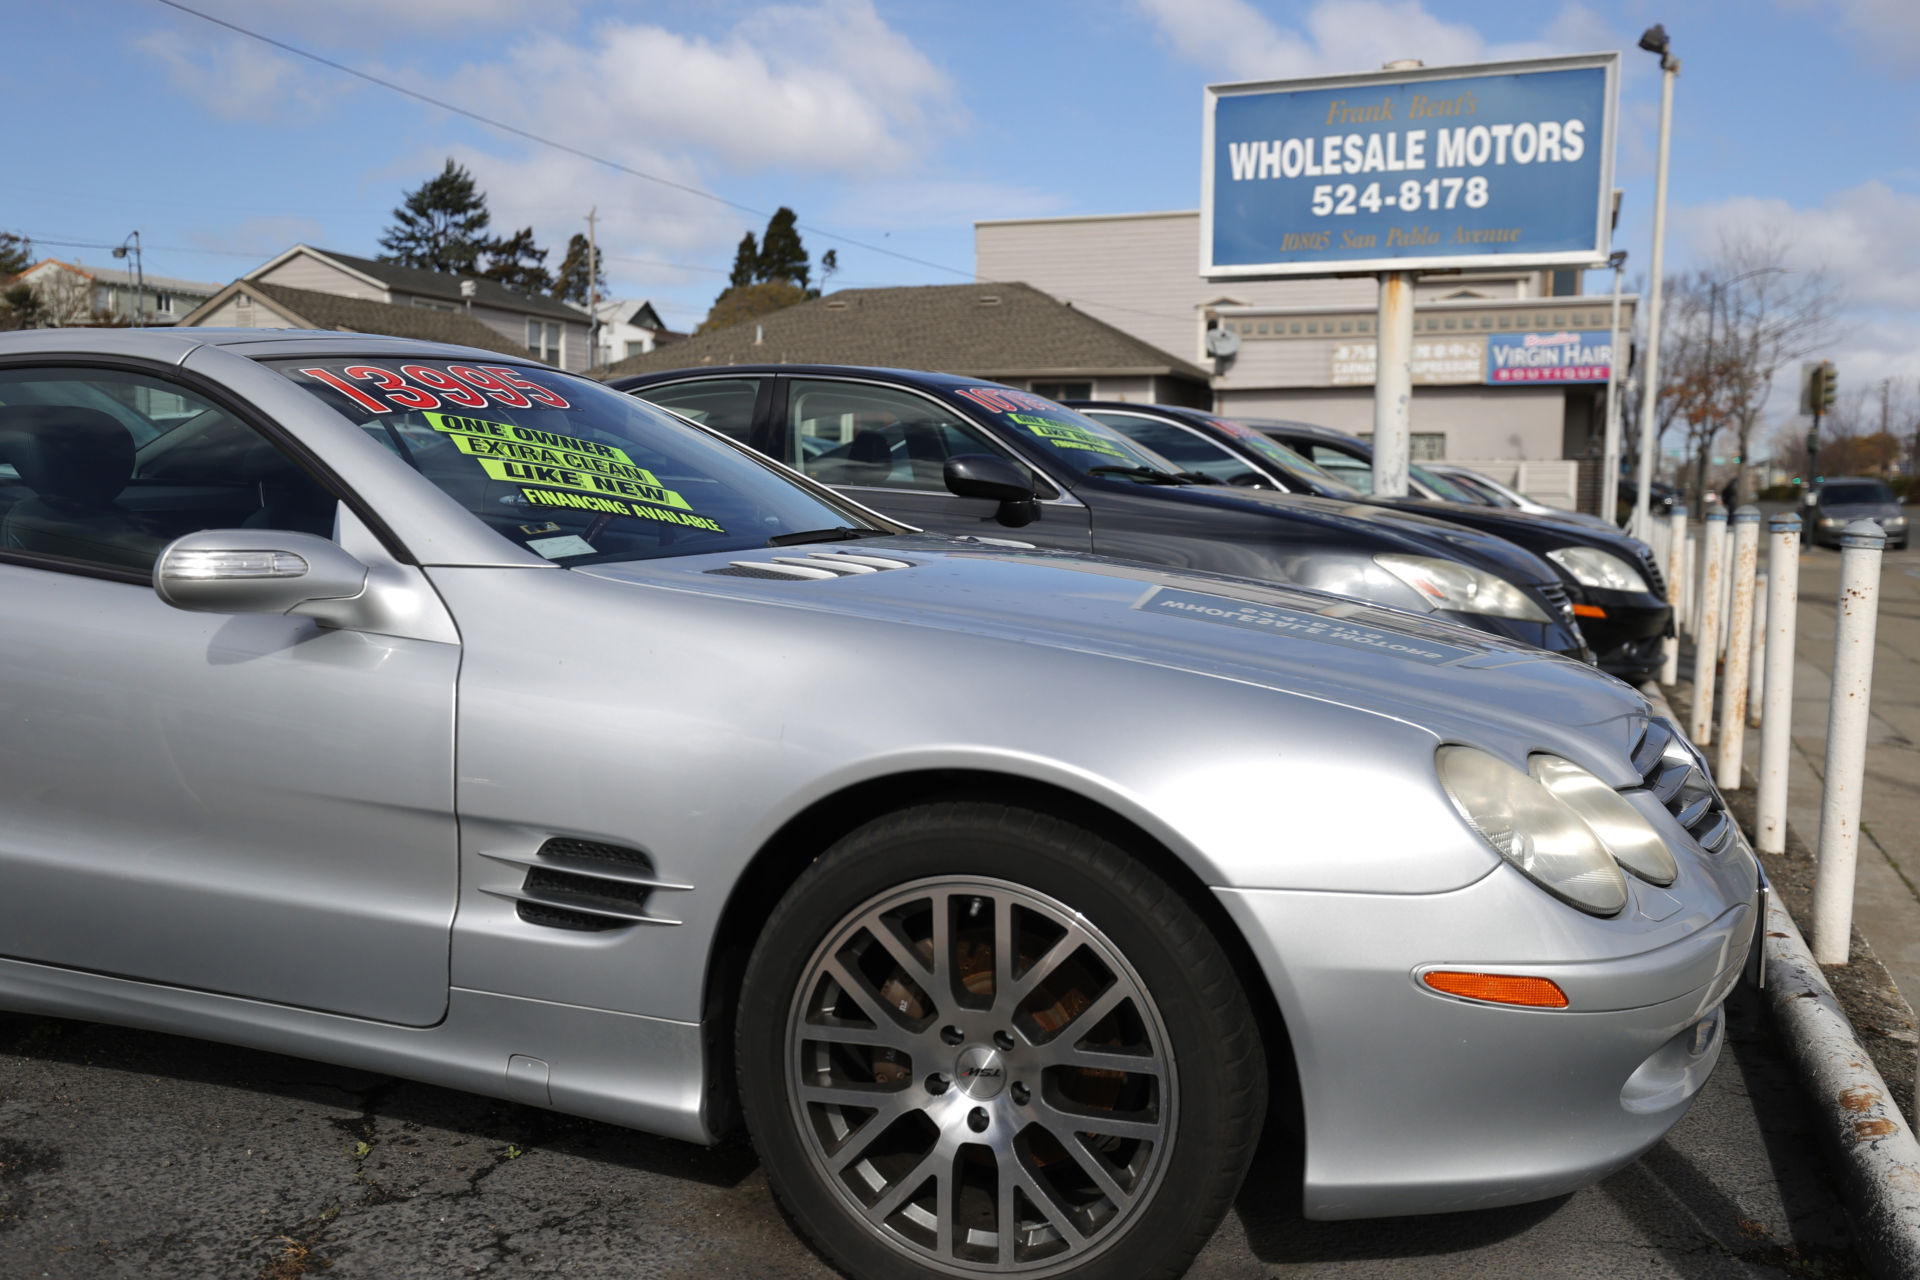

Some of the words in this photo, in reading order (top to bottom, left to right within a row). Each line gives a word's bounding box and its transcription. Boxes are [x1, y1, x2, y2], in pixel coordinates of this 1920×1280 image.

[1326, 97, 1396, 125] Frank
[1408, 90, 1478, 120] Bent's
[1229, 129, 1427, 181] WHOLESALE
[1436, 118, 1585, 168] MOTORS
[1311, 176, 1489, 217] 524-8178
[1339, 229, 1377, 250] San
[1385, 226, 1440, 248] Pablo
[1449, 225, 1522, 244] Avenue
[299, 364, 571, 413] 13995
[1499, 368, 1604, 380] BOUTIQUE
[440, 415, 510, 437] ONE
[512, 425, 617, 460] OWNER
[467, 437, 559, 464] EXTRA
[563, 453, 650, 483] CLEAN
[504, 462, 587, 488] LIKE
[590, 475, 671, 505] NEW
[521, 487, 630, 516] FINANCING
[633, 505, 725, 533] AVAILABLE
